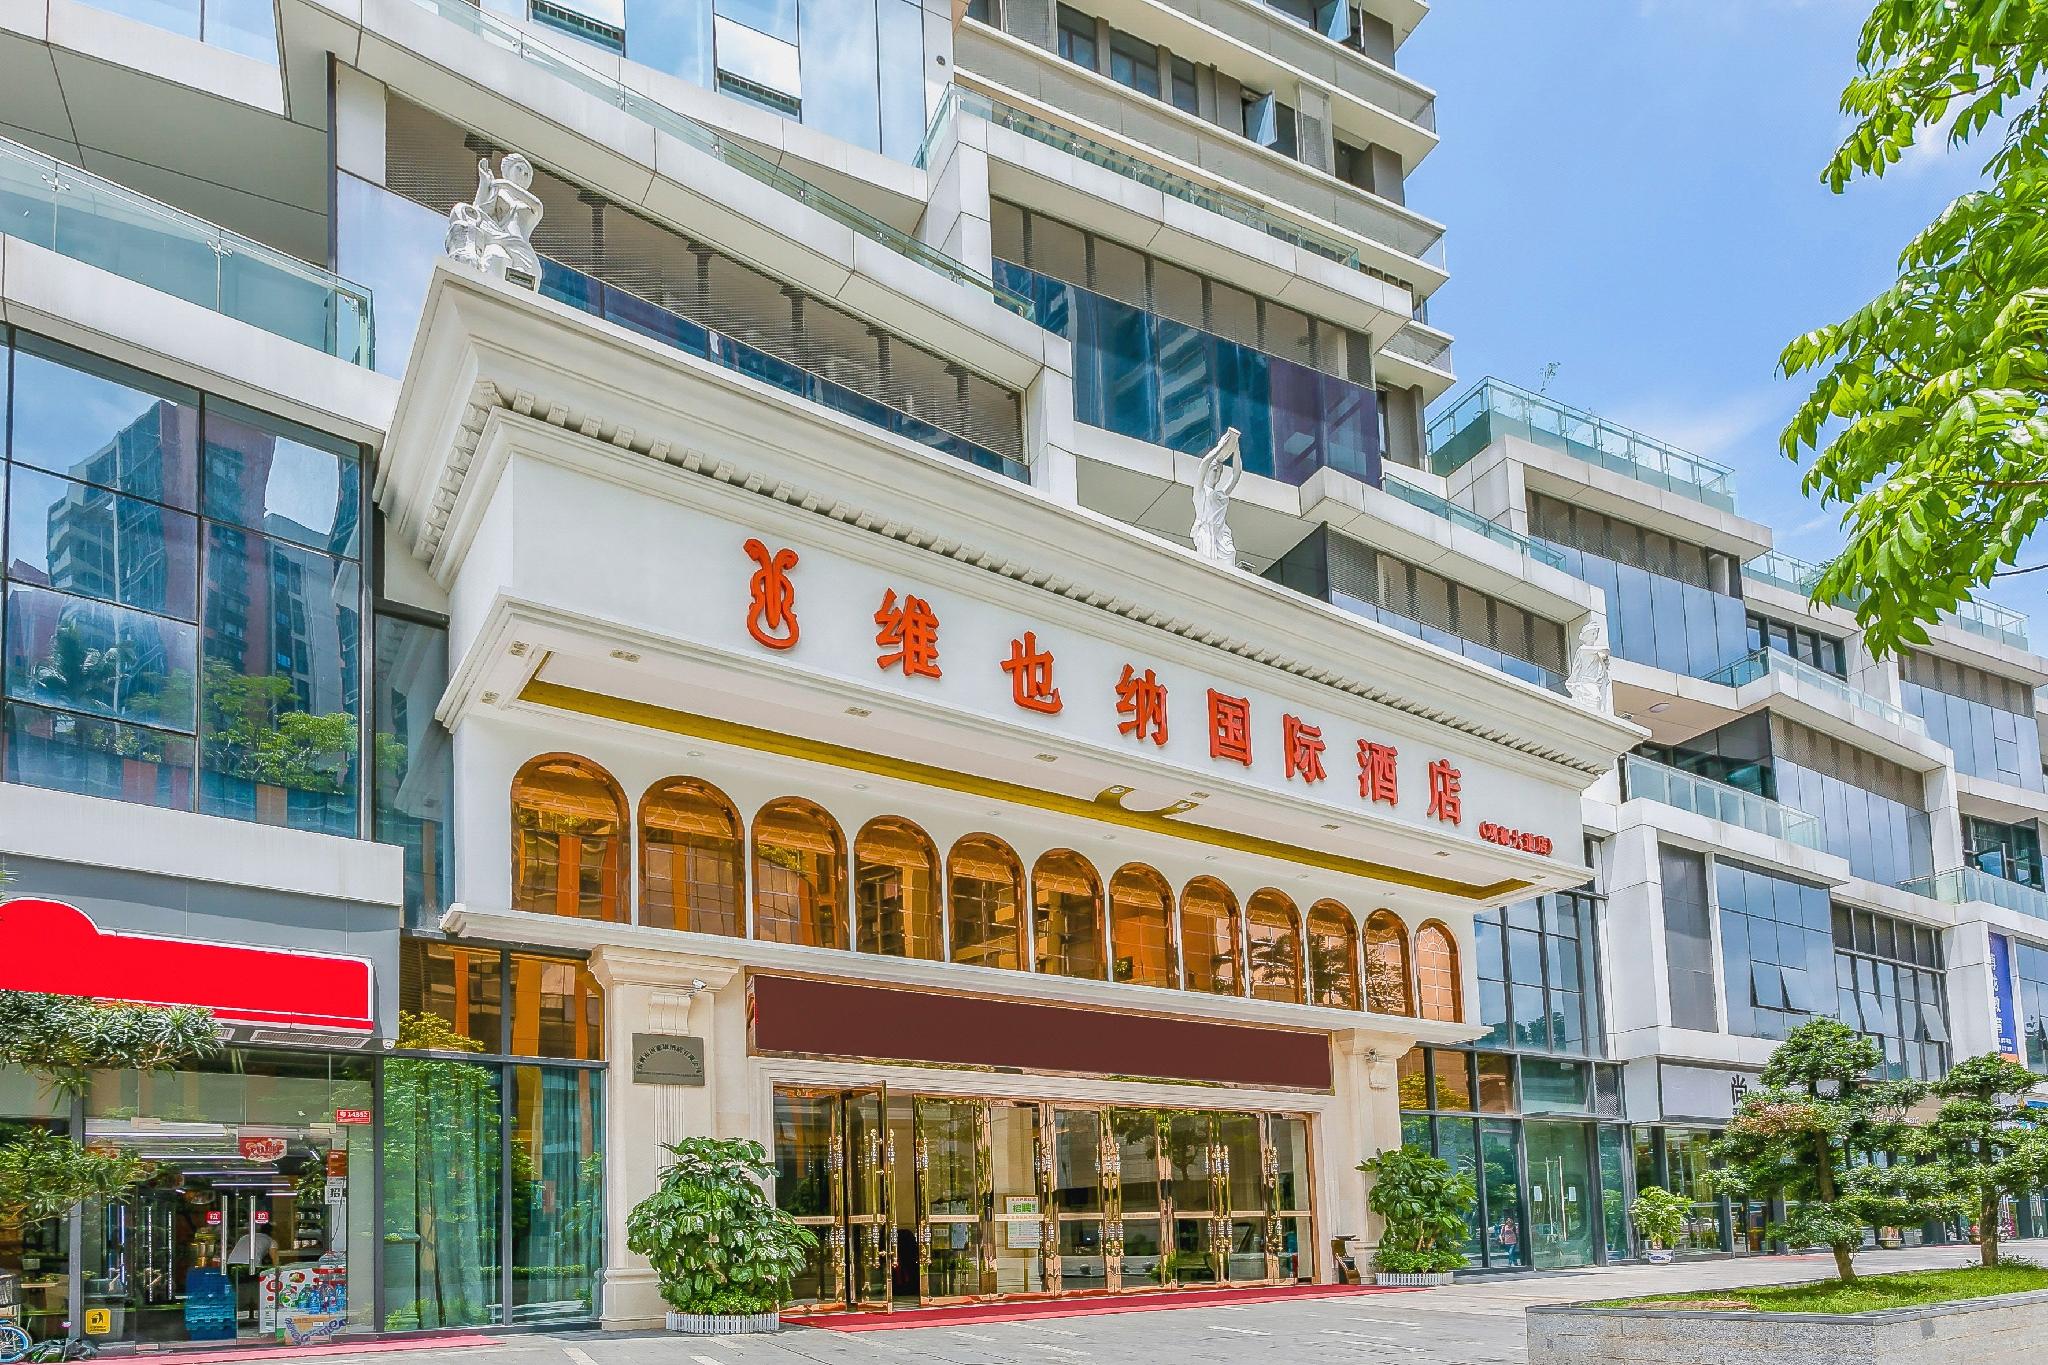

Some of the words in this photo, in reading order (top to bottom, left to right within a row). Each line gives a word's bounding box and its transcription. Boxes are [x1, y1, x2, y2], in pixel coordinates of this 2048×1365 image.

[873, 588, 1461, 824] 维也纳国际酒店
[1012, 1203, 1032, 1213] 招聘
